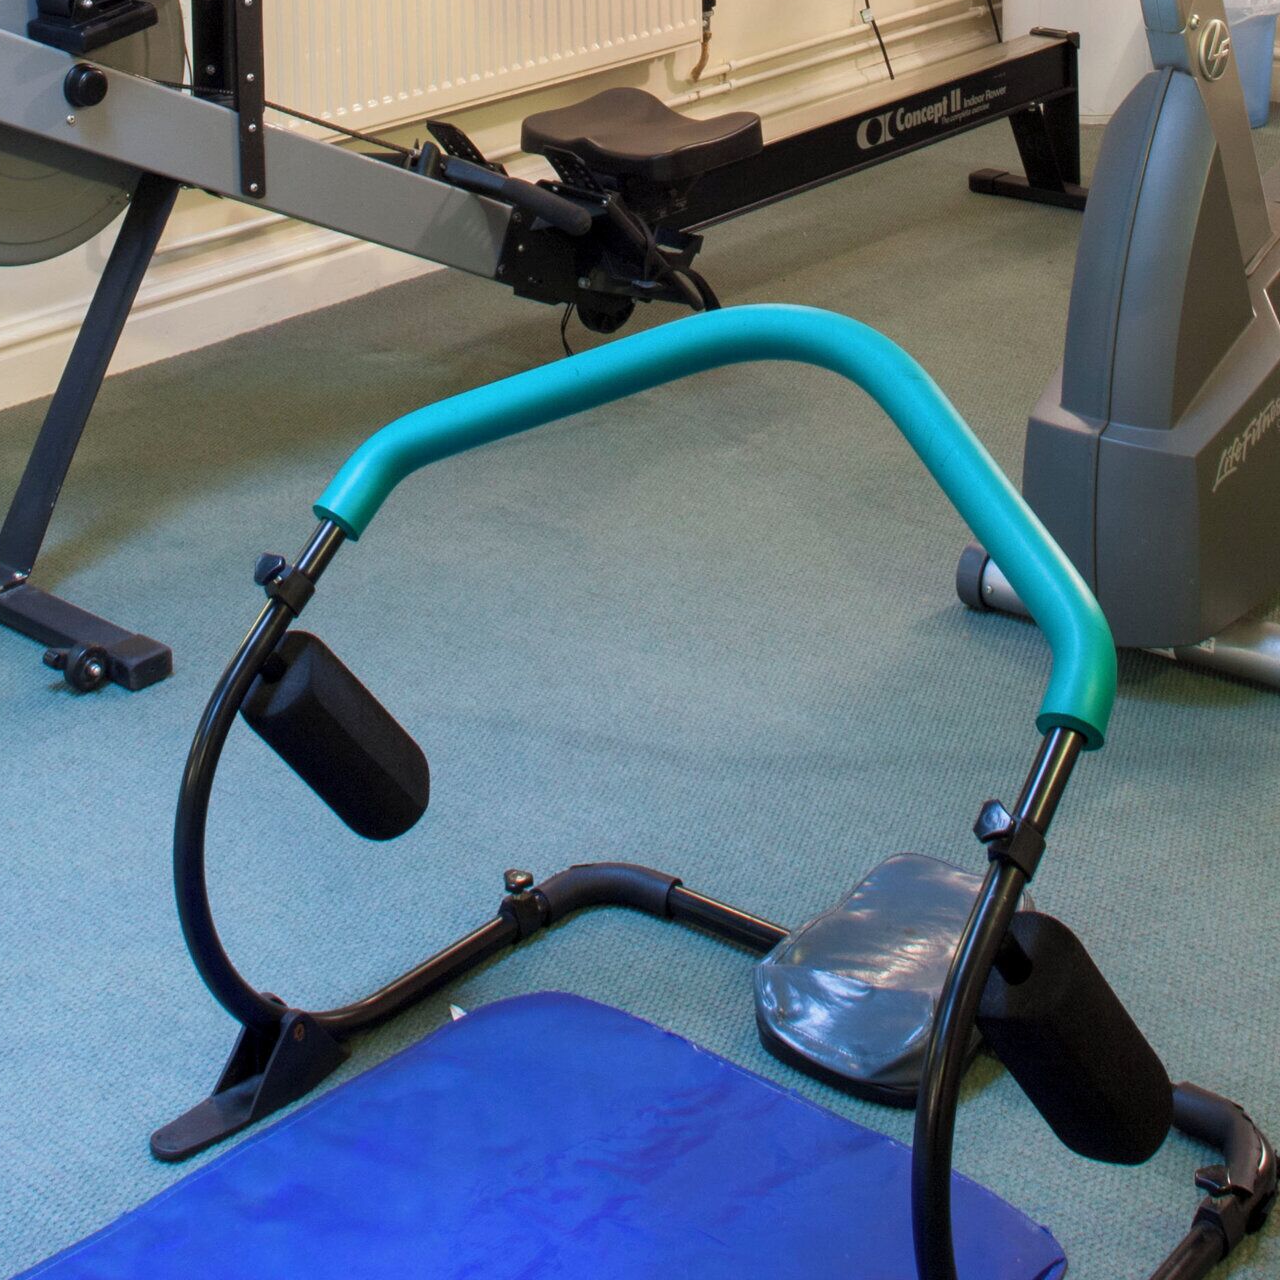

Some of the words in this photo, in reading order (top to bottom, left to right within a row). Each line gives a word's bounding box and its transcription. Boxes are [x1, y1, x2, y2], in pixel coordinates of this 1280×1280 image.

[896, 96, 948, 131] Concept
[951, 88, 961, 112] II
[964, 94, 985, 108] Indoor
[986, 86, 1007, 100] Rower
